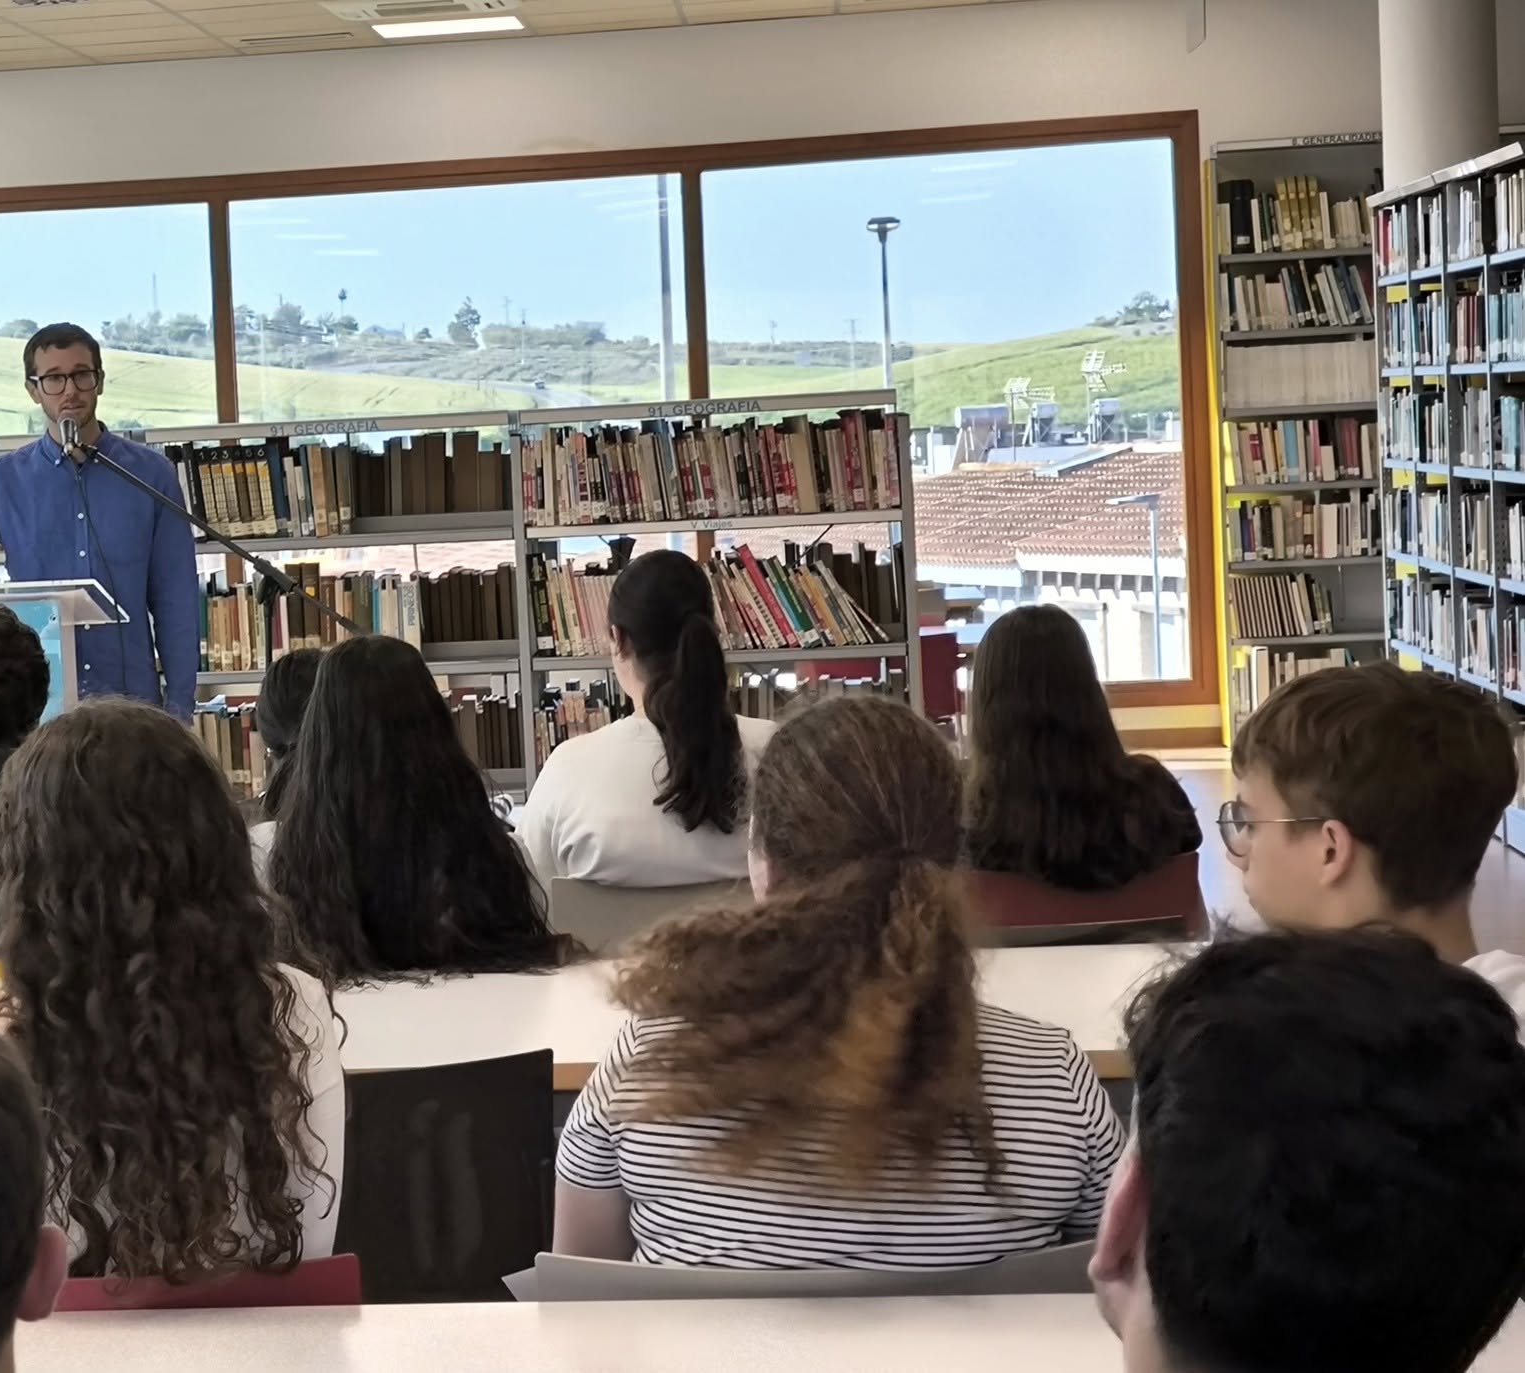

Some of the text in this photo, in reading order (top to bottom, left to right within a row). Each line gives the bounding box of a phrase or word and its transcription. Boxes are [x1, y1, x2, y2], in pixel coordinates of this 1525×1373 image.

[648, 400, 762, 418] 91. GEOGRAFIA
[294, 420, 379, 436] GEOGRAFIA
[210, 451, 218, 460] 2
[221, 450, 229, 459] 3
[257, 448, 265, 457] 6
[703, 519, 733, 530] Viajes
